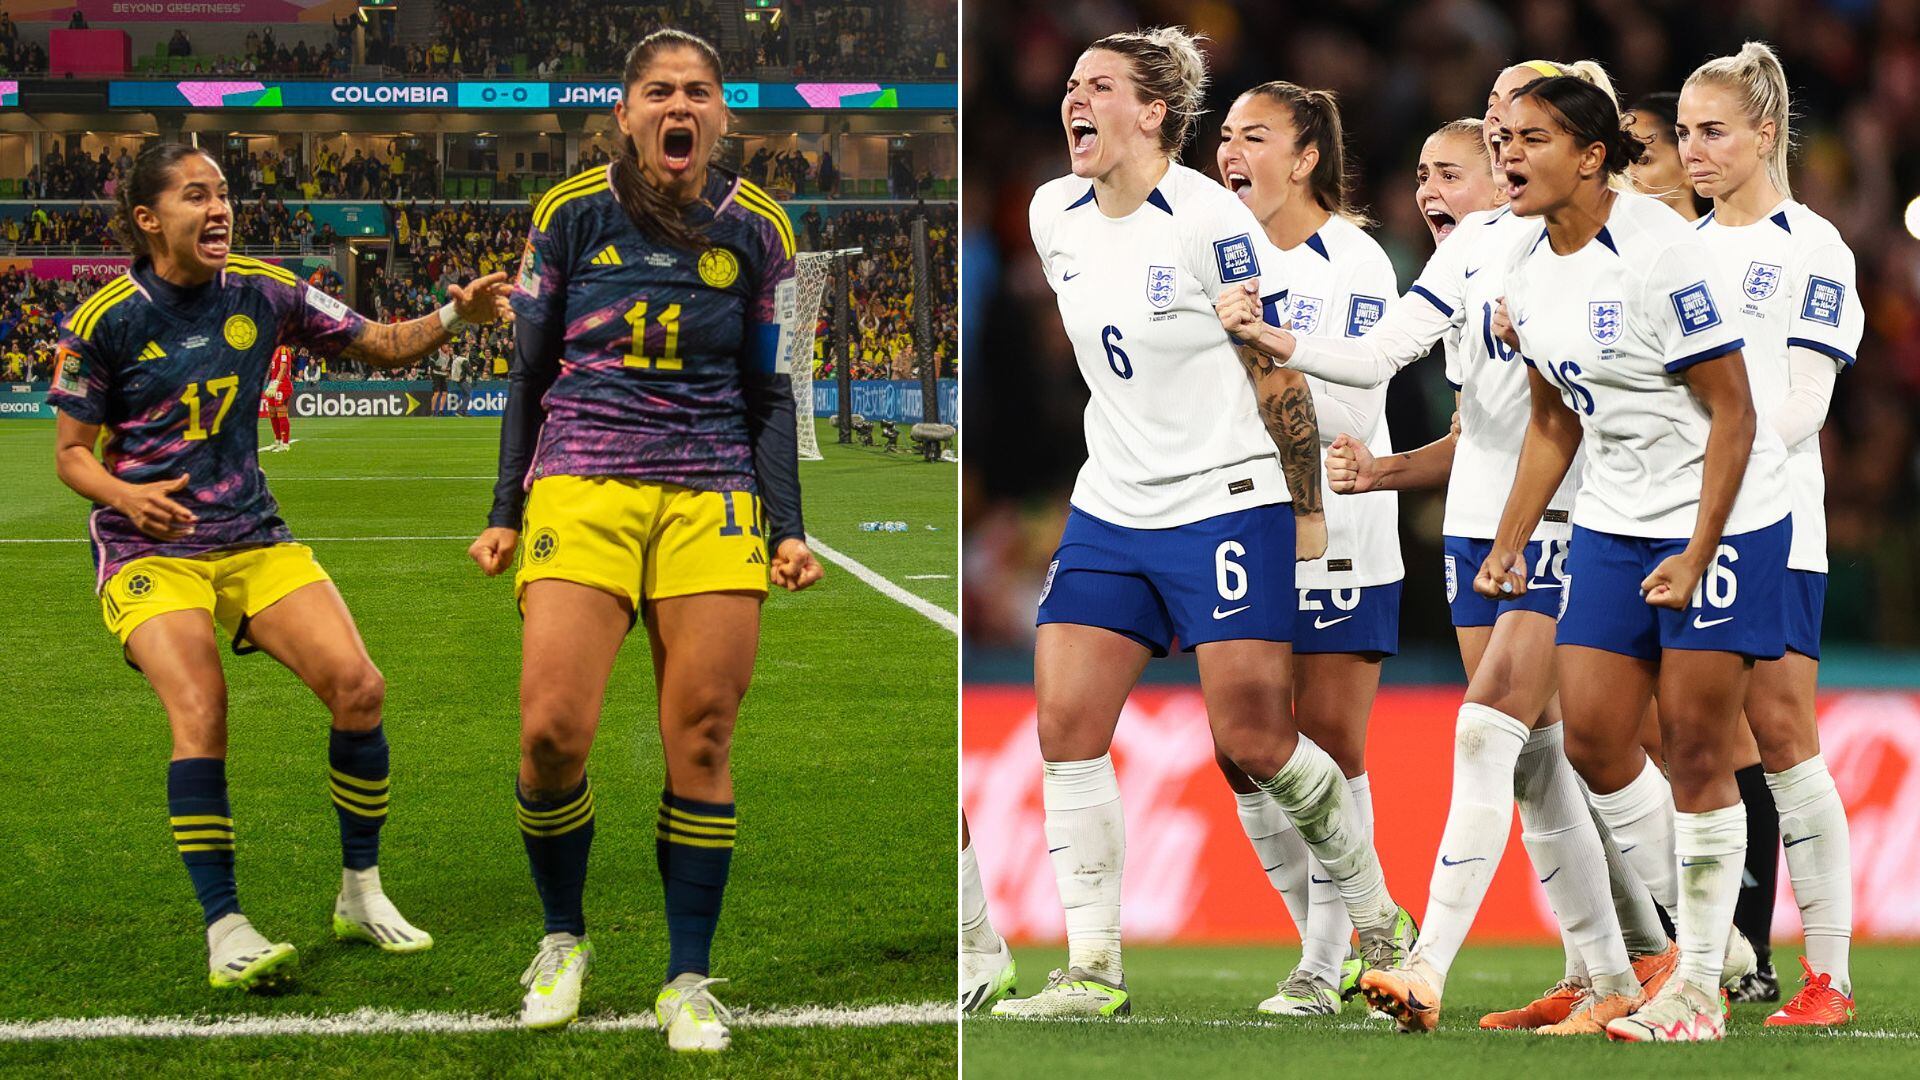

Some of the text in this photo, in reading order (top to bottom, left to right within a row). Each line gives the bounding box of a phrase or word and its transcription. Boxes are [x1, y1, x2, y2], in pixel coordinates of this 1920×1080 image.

[112, 4, 241, 13] BEYOND GREATNESS
[331, 87, 448, 103] COLOMBIA
[1223, 241, 1246, 254] FOOTBALL
[1224, 248, 1248, 261] UNITES
[72, 264, 127, 275] BEYOND
[1814, 290, 1837, 303] UNITES
[1683, 298, 1706, 312] UNITES
[1356, 309, 1379, 319] UNITES
[623, 302, 683, 370] 11
[1101, 325, 1133, 379] 6
[0, 402, 40, 413] exona
[180, 375, 239, 440] 17
[295, 392, 403, 416] Globant
[1215, 540, 1248, 601] 6
